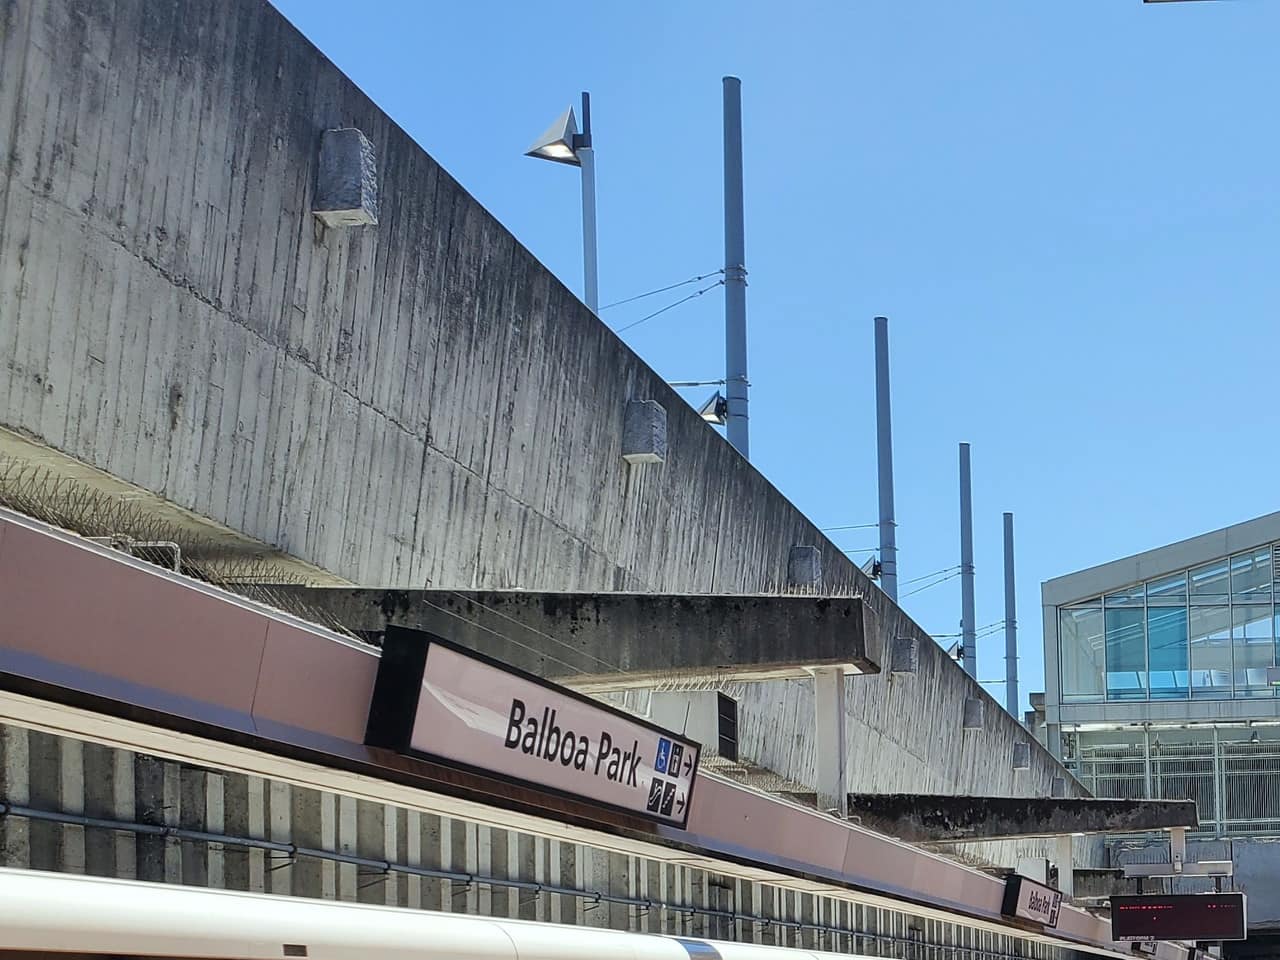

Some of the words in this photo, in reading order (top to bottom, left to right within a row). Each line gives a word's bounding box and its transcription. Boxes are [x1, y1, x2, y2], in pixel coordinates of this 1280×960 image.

[504, 698, 590, 771] Balboa
[594, 731, 642, 788] Park
[1028, 890, 1042, 913] Balboa
[1041, 896, 1051, 915] Park
